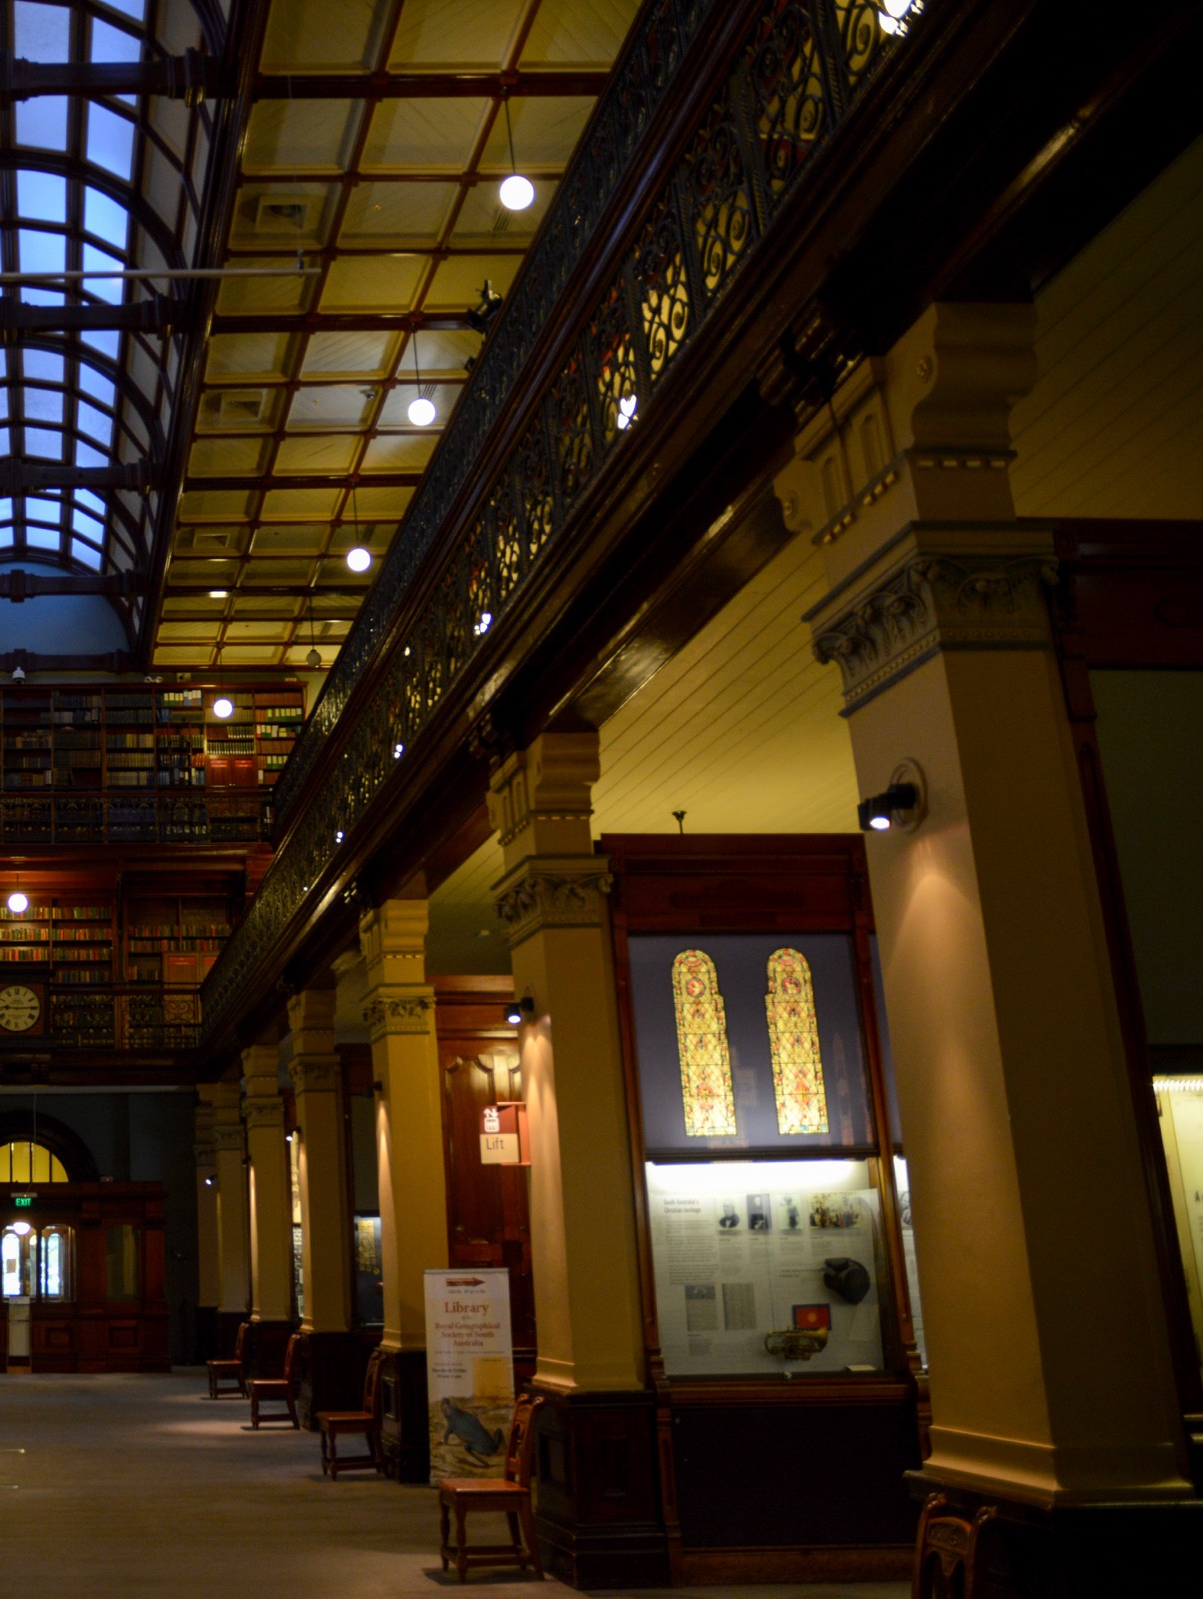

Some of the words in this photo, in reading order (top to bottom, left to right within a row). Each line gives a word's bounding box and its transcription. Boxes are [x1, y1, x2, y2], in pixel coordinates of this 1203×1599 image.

[486, 1137, 505, 1150] Lift
[16, 1198, 31, 1206] EXIT
[445, 1302, 489, 1316] Library
[435, 1322, 453, 1330] Royal
[454, 1322, 501, 1331] Geographical
[441, 1331, 464, 1339] Society
[453, 1339, 484, 1347] Australia
